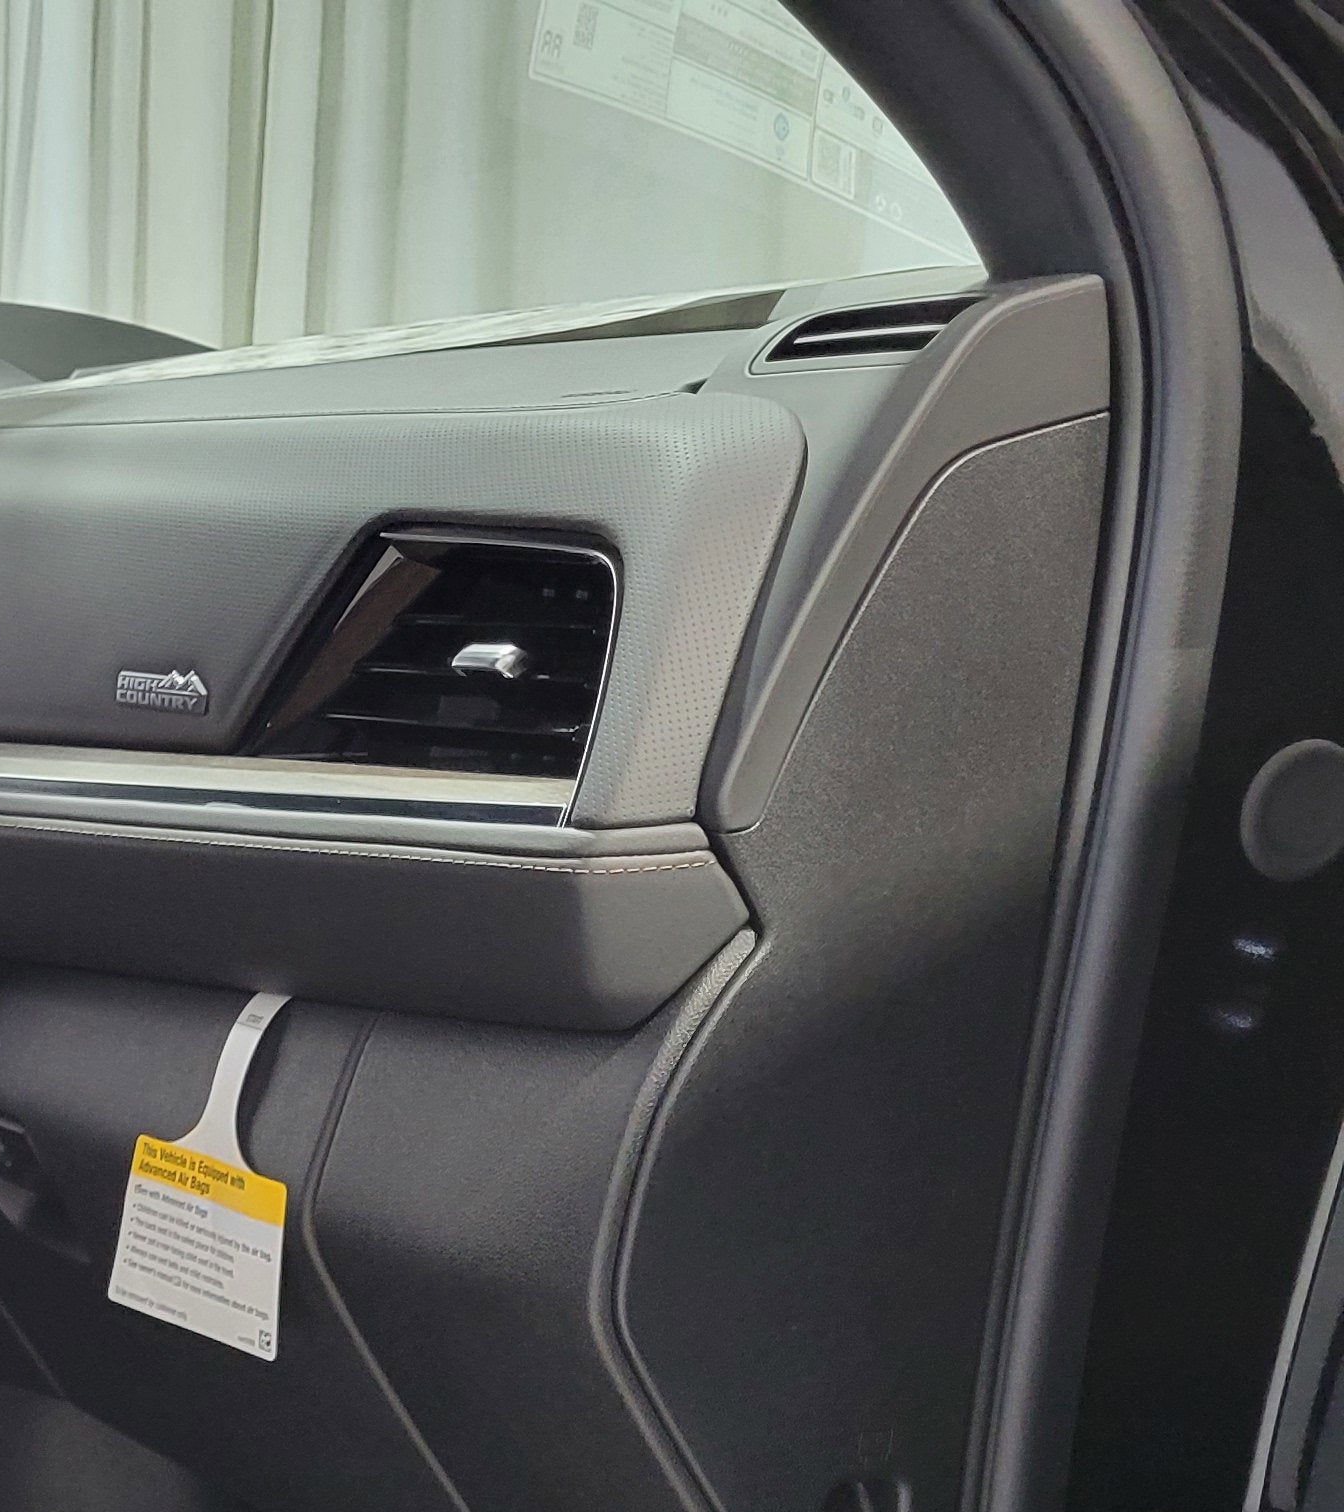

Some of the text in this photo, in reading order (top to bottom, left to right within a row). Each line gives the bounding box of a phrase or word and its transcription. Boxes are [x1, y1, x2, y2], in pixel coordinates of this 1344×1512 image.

[117, 676, 159, 691] HIGH
[116, 689, 198, 711] COUNTRY
[139, 1159, 211, 1195] Advanced Air Bags
[142, 1142, 157, 1159] This
[160, 1147, 187, 1168] Vehicle
[198, 1160, 229, 1184] Equipped
[230, 1174, 245, 1190] with
